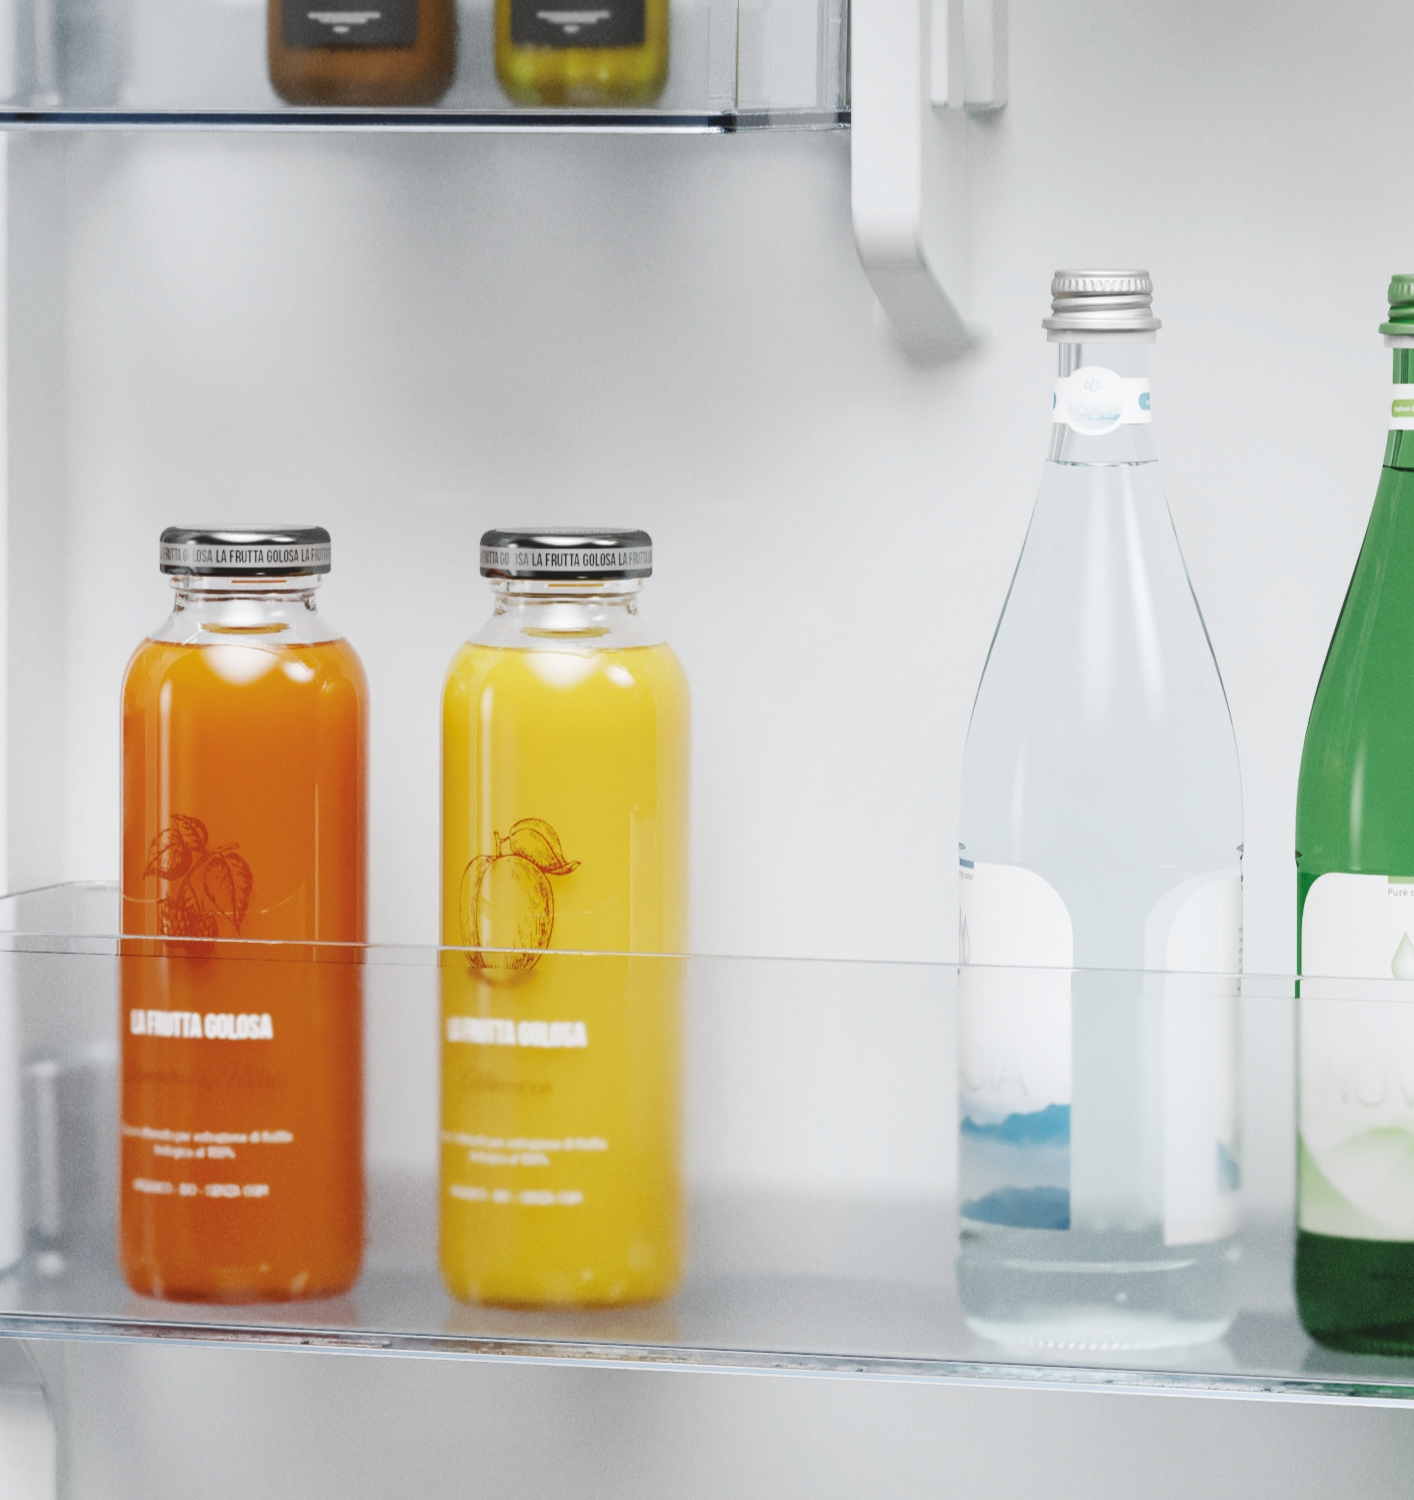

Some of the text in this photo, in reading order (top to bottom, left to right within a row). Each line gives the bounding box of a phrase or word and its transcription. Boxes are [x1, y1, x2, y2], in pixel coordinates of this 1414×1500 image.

[216, 550, 226, 564] LA
[229, 549, 264, 564] FRUTTA
[266, 548, 299, 563] GOLOSA
[301, 548, 311, 562] LA
[532, 552, 543, 567] LA
[545, 552, 580, 567] FRUTTA
[582, 552, 616, 567] GOLOSA
[618, 552, 628, 566] LA
[1387, 888, 1408, 897] Pure
[203, 1012, 274, 1040] GOLOSA
